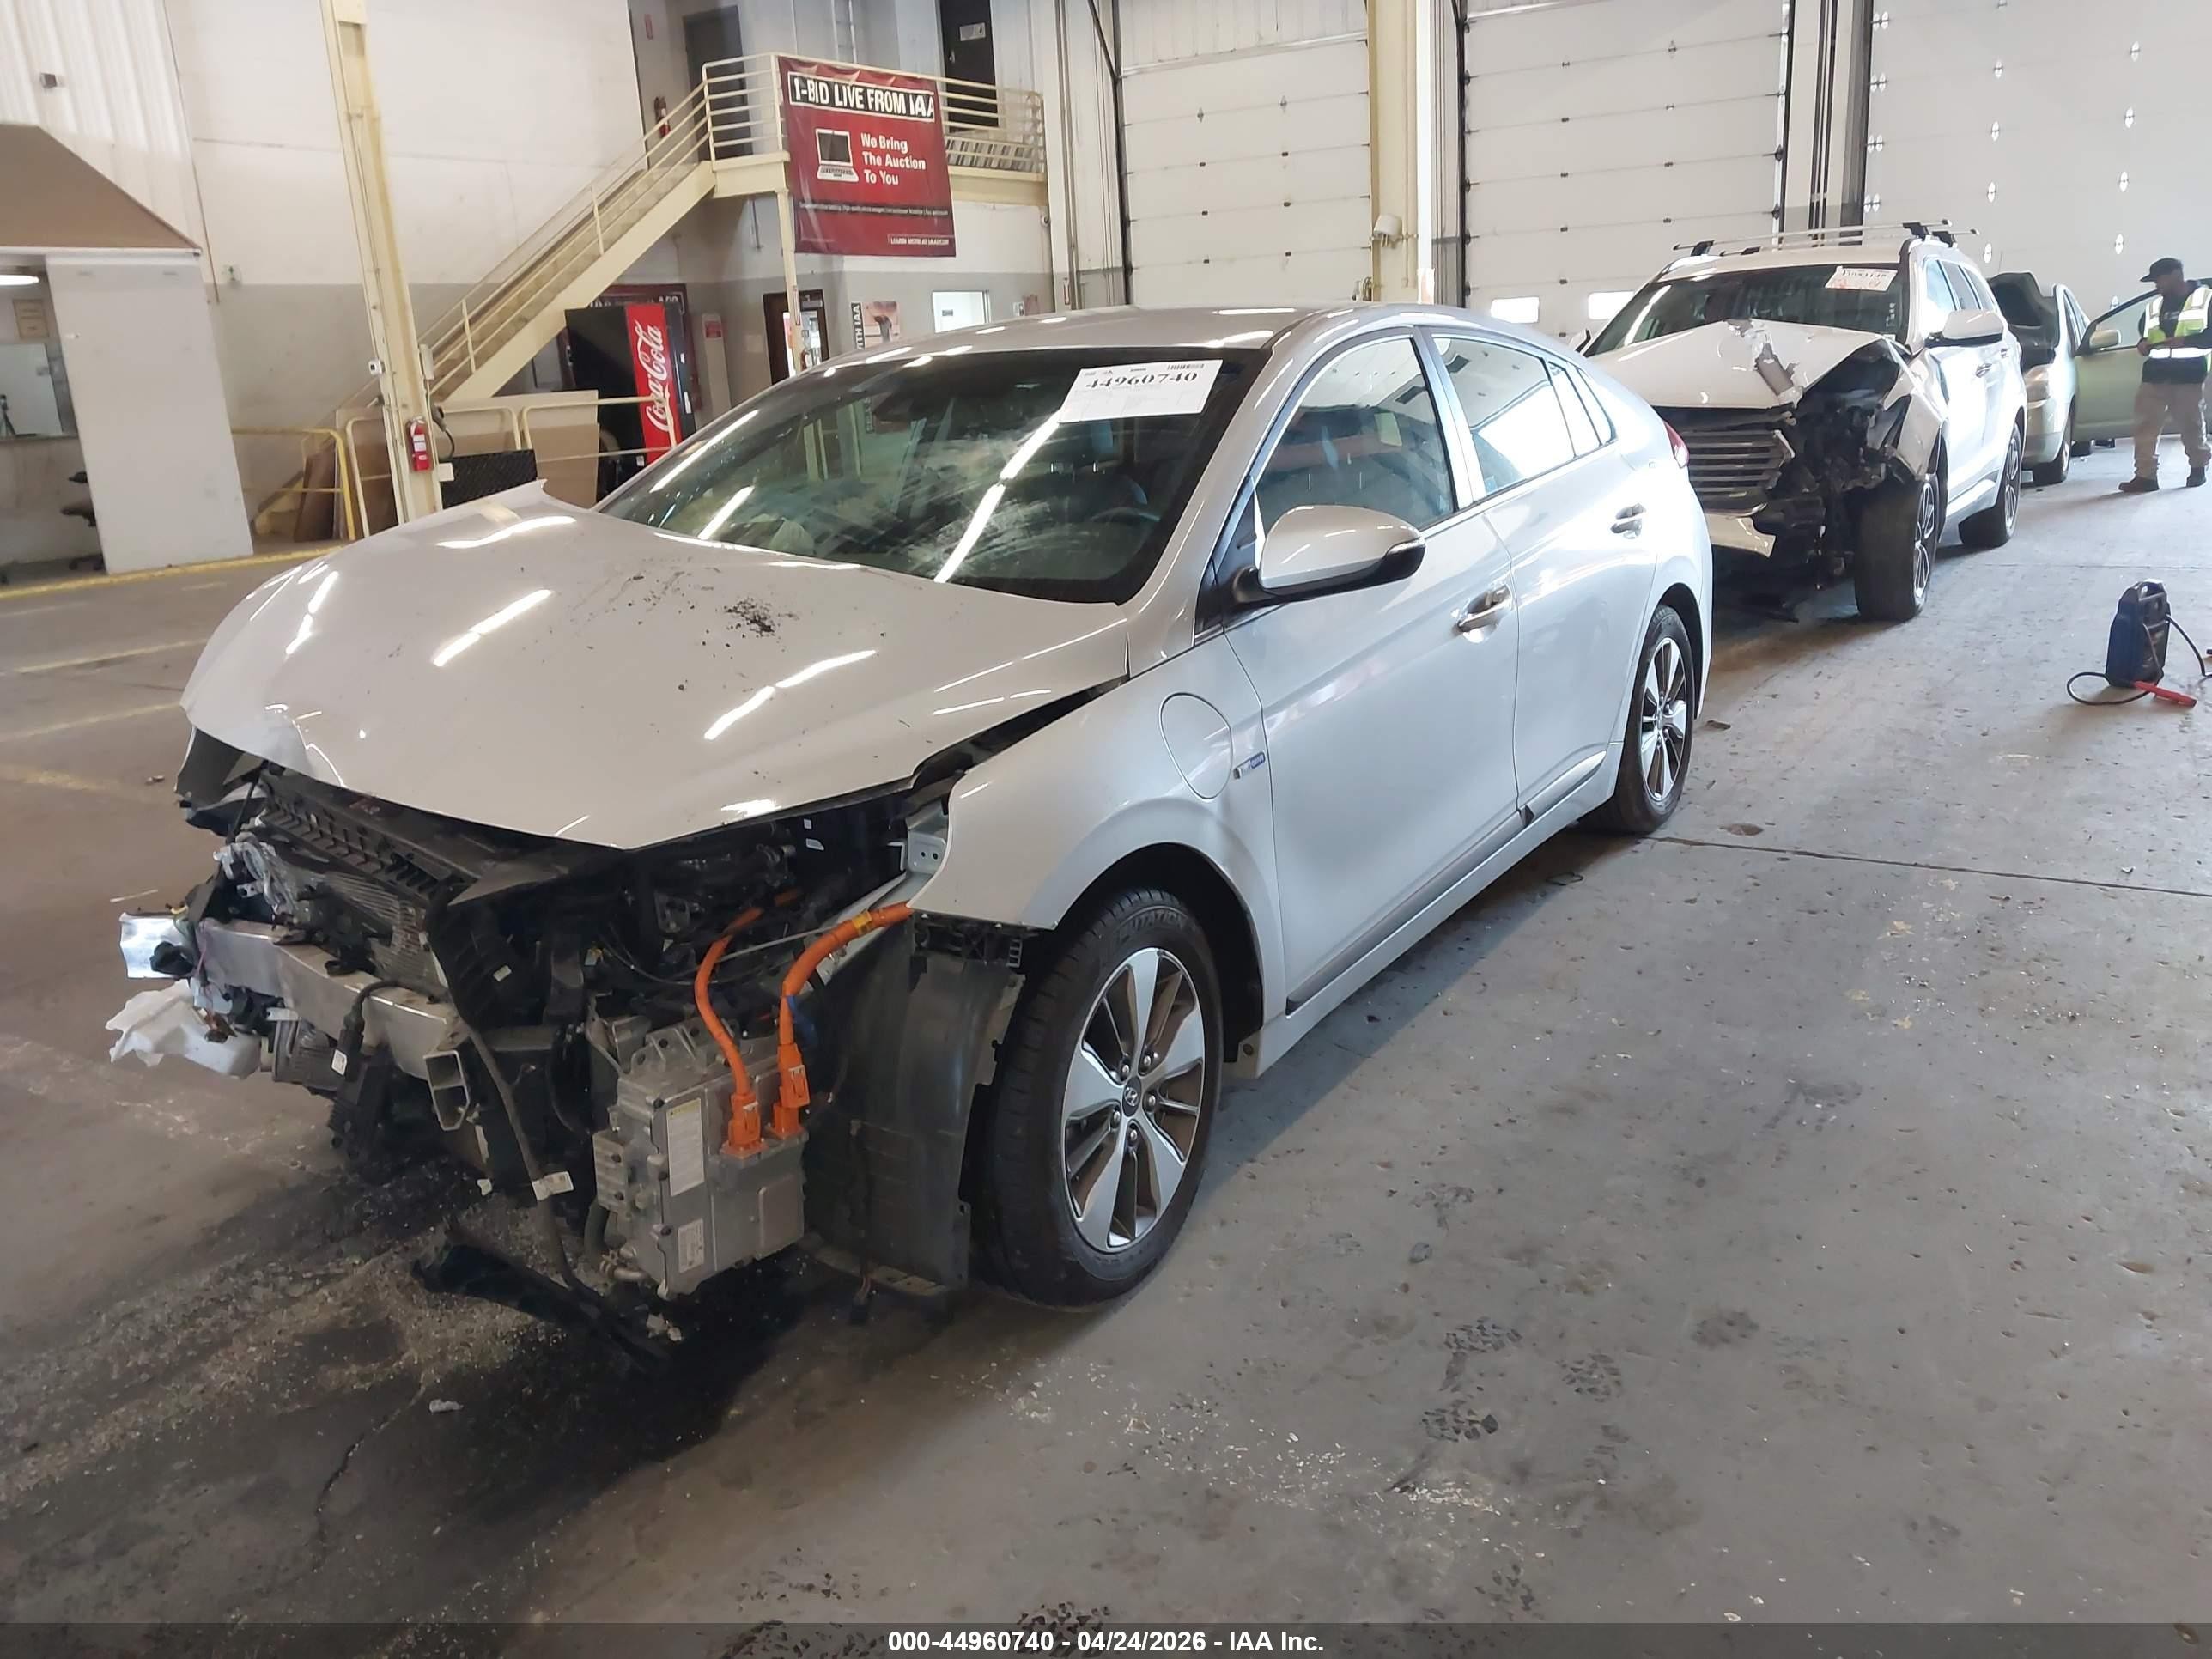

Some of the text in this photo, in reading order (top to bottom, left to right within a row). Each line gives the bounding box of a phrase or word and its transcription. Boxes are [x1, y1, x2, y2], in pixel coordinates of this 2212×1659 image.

[793, 77, 830, 105] I-BID
[834, 83, 865, 109] LIVE
[866, 88, 907, 115] FROM
[860, 132, 908, 155] We Bring
[861, 150, 926, 170] The Auction
[863, 168, 899, 186] To You
[853, 304, 861, 325] IAA
[1085, 372, 1198, 389] 44960740
